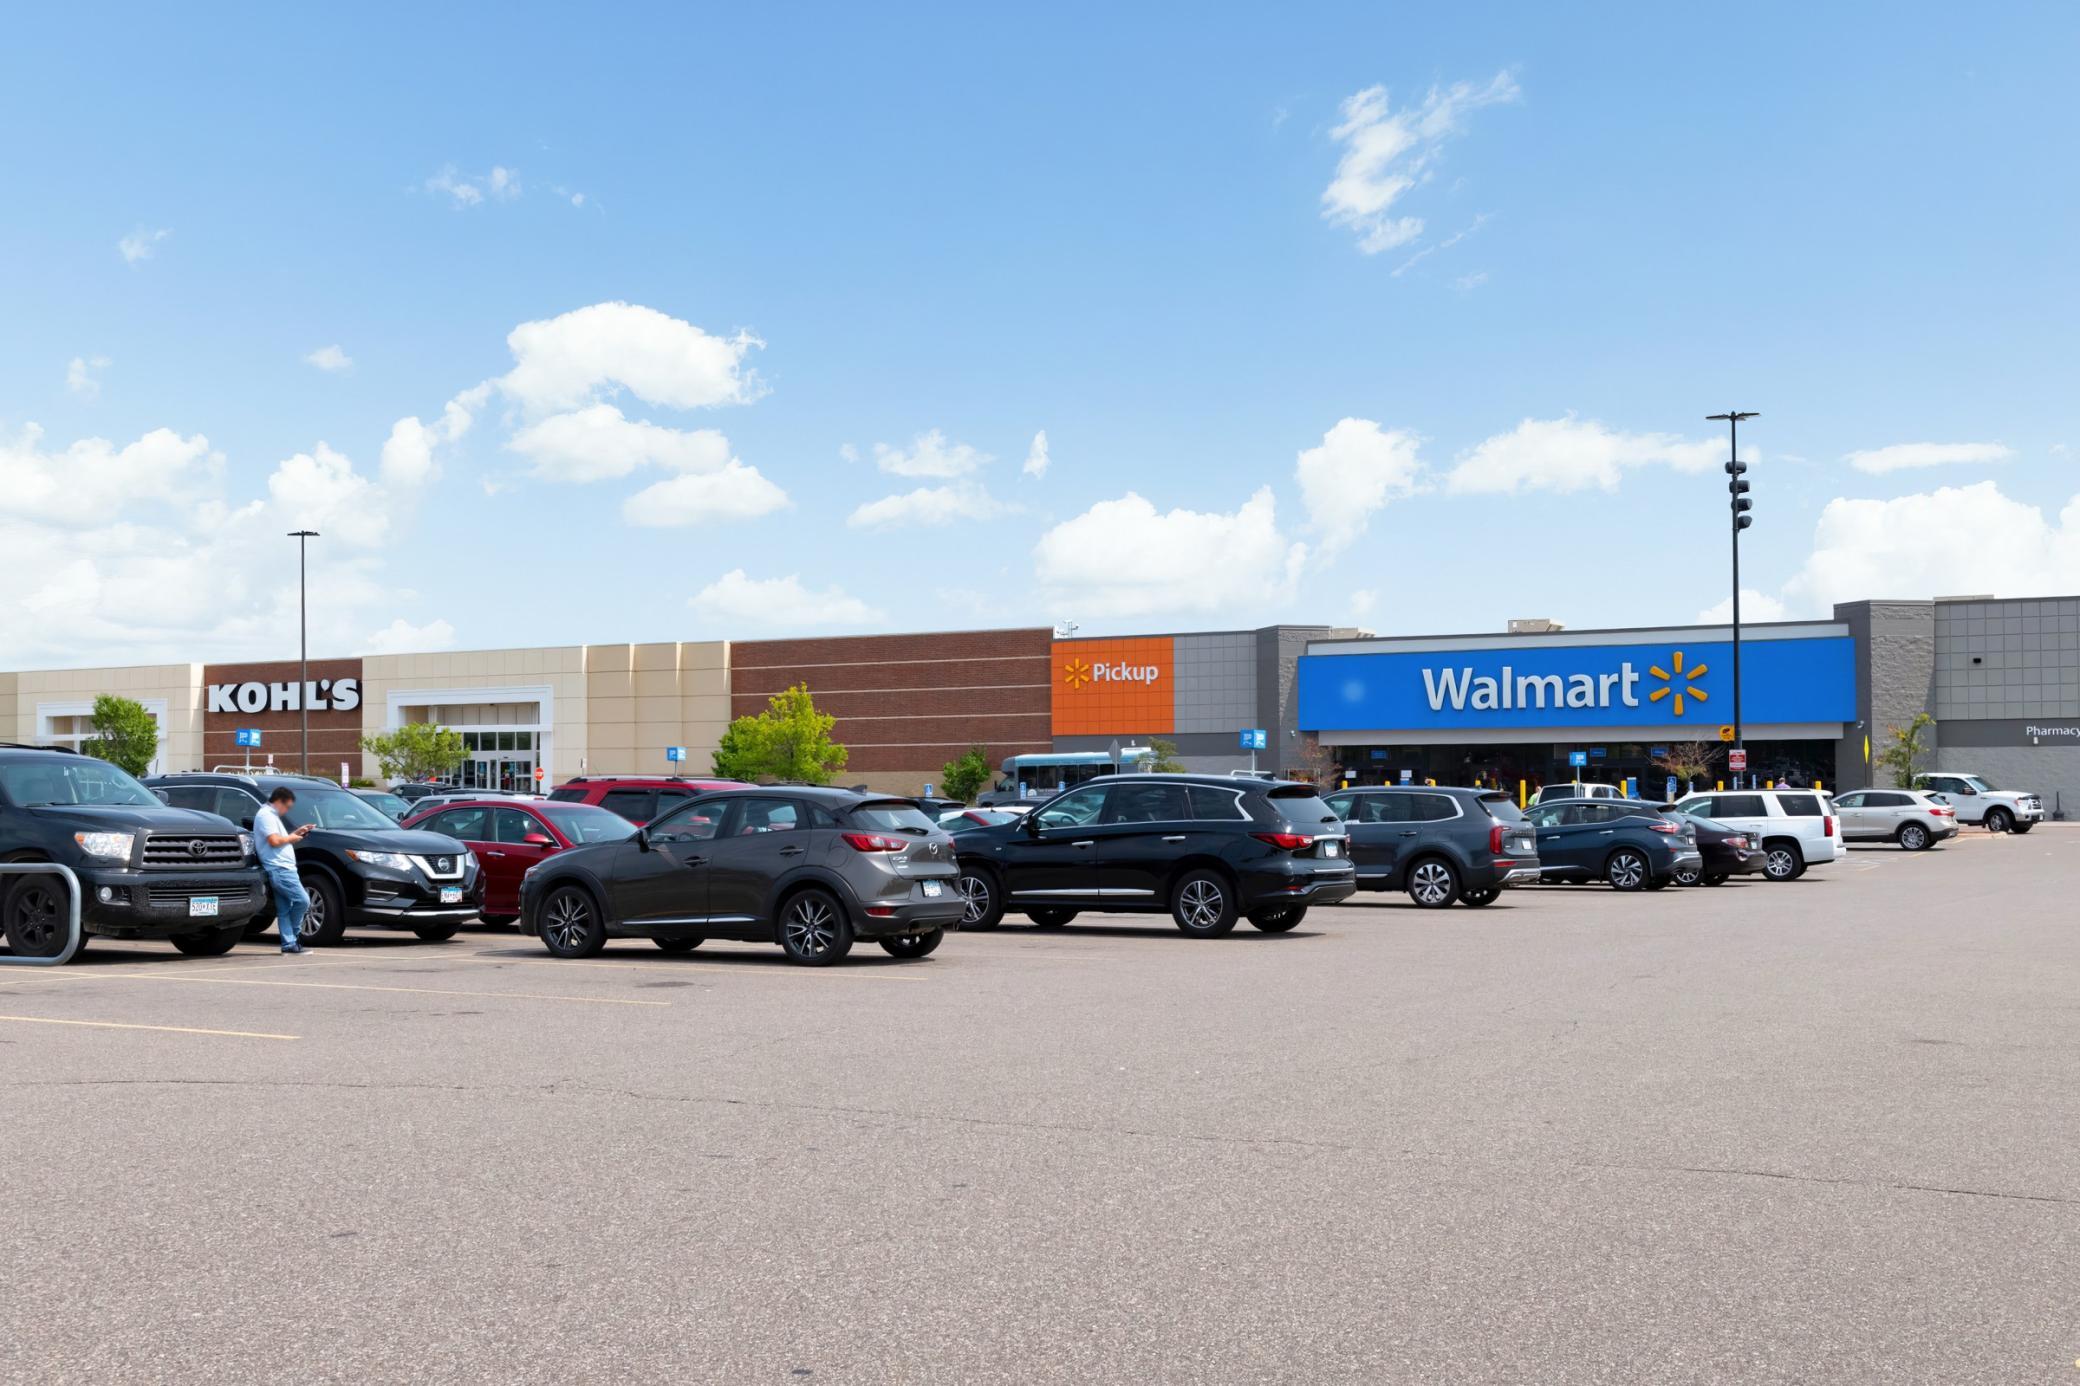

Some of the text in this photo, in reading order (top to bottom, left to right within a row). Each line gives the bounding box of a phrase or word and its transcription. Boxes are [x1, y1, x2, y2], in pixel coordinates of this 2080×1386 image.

[1093, 661, 1159, 685] Pickup
[1421, 662, 1640, 711] Walmart
[207, 678, 360, 714] KOHL'S
